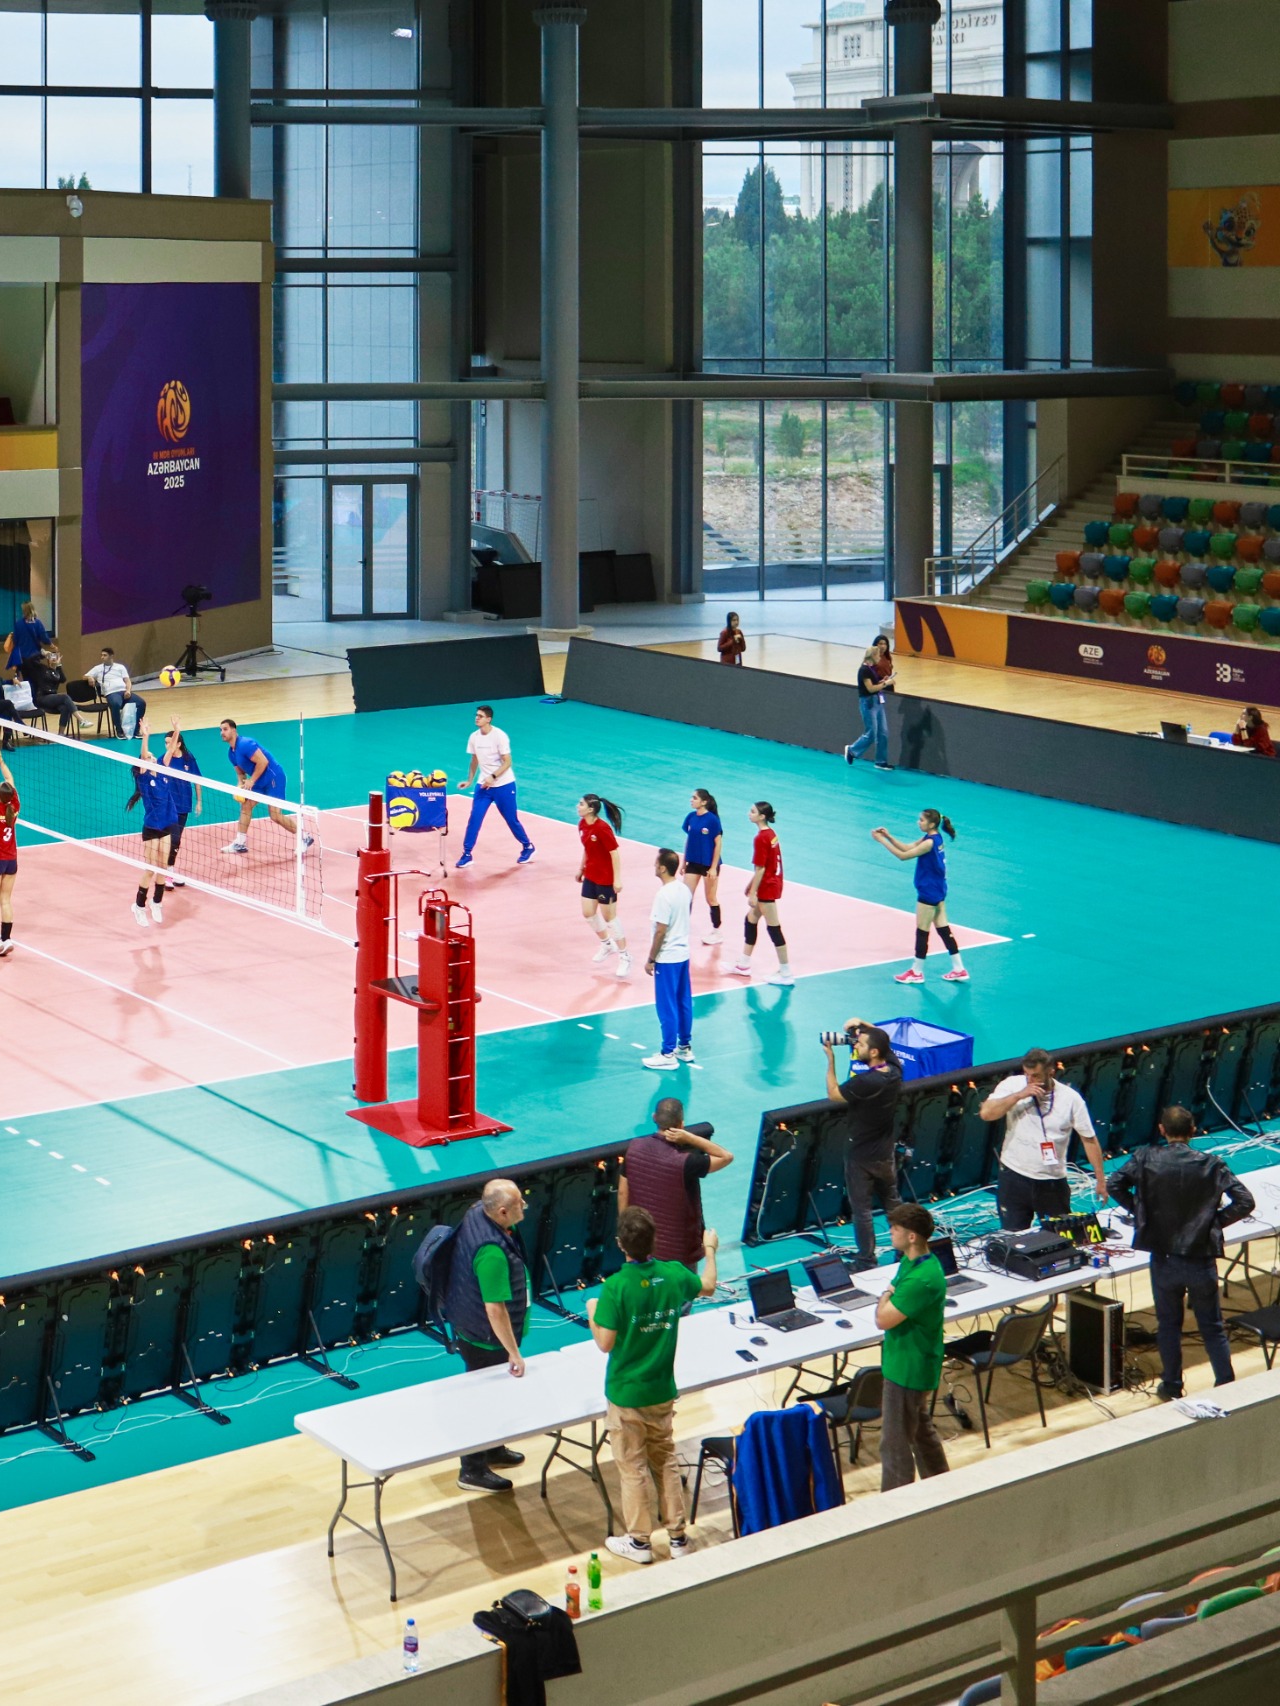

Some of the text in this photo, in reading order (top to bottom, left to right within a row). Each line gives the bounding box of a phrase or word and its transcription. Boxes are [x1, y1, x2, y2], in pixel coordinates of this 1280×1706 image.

[147, 458, 200, 475] AZƏRBAYCAN
[164, 475, 185, 490] 2025
[1083, 646, 1100, 657] AZE
[3, 827, 12, 841] 3
[1086, 1224, 1102, 1243] 21
